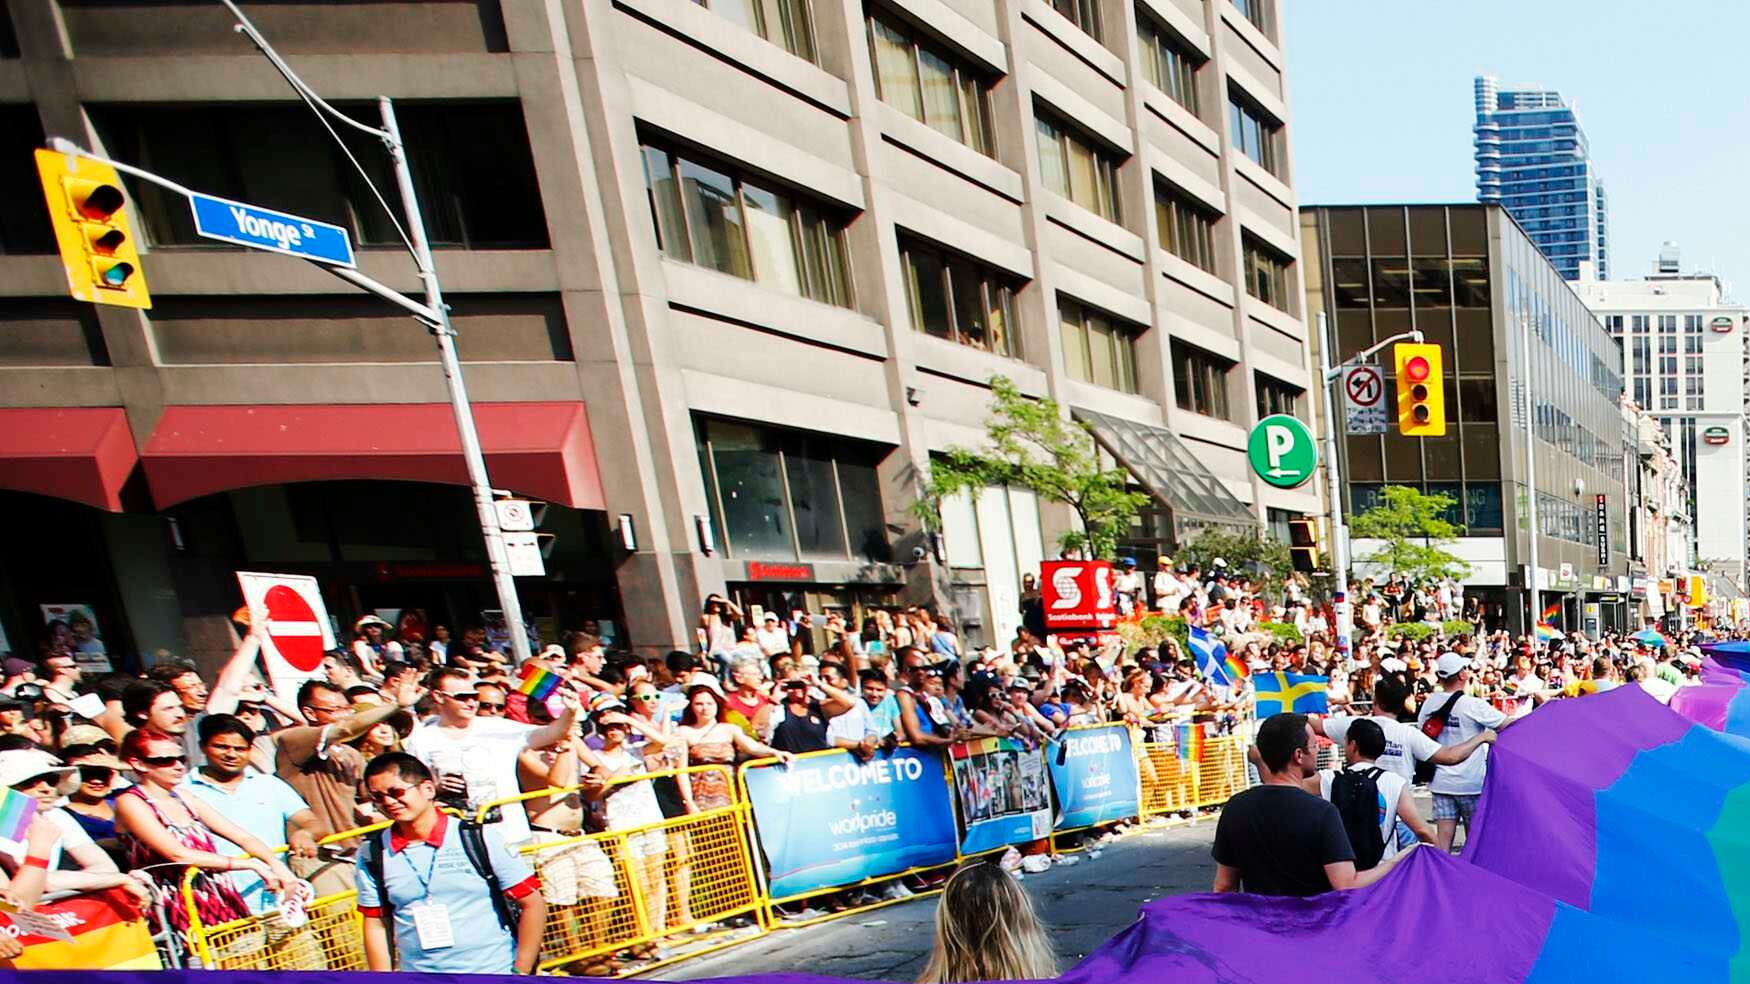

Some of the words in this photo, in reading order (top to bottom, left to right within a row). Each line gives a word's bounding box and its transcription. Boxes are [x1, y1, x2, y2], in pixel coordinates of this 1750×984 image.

[229, 206, 302, 250] Yonge
[1265, 424, 1295, 468] P
[774, 759, 892, 795] WELCOME
[892, 756, 923, 781] TO
